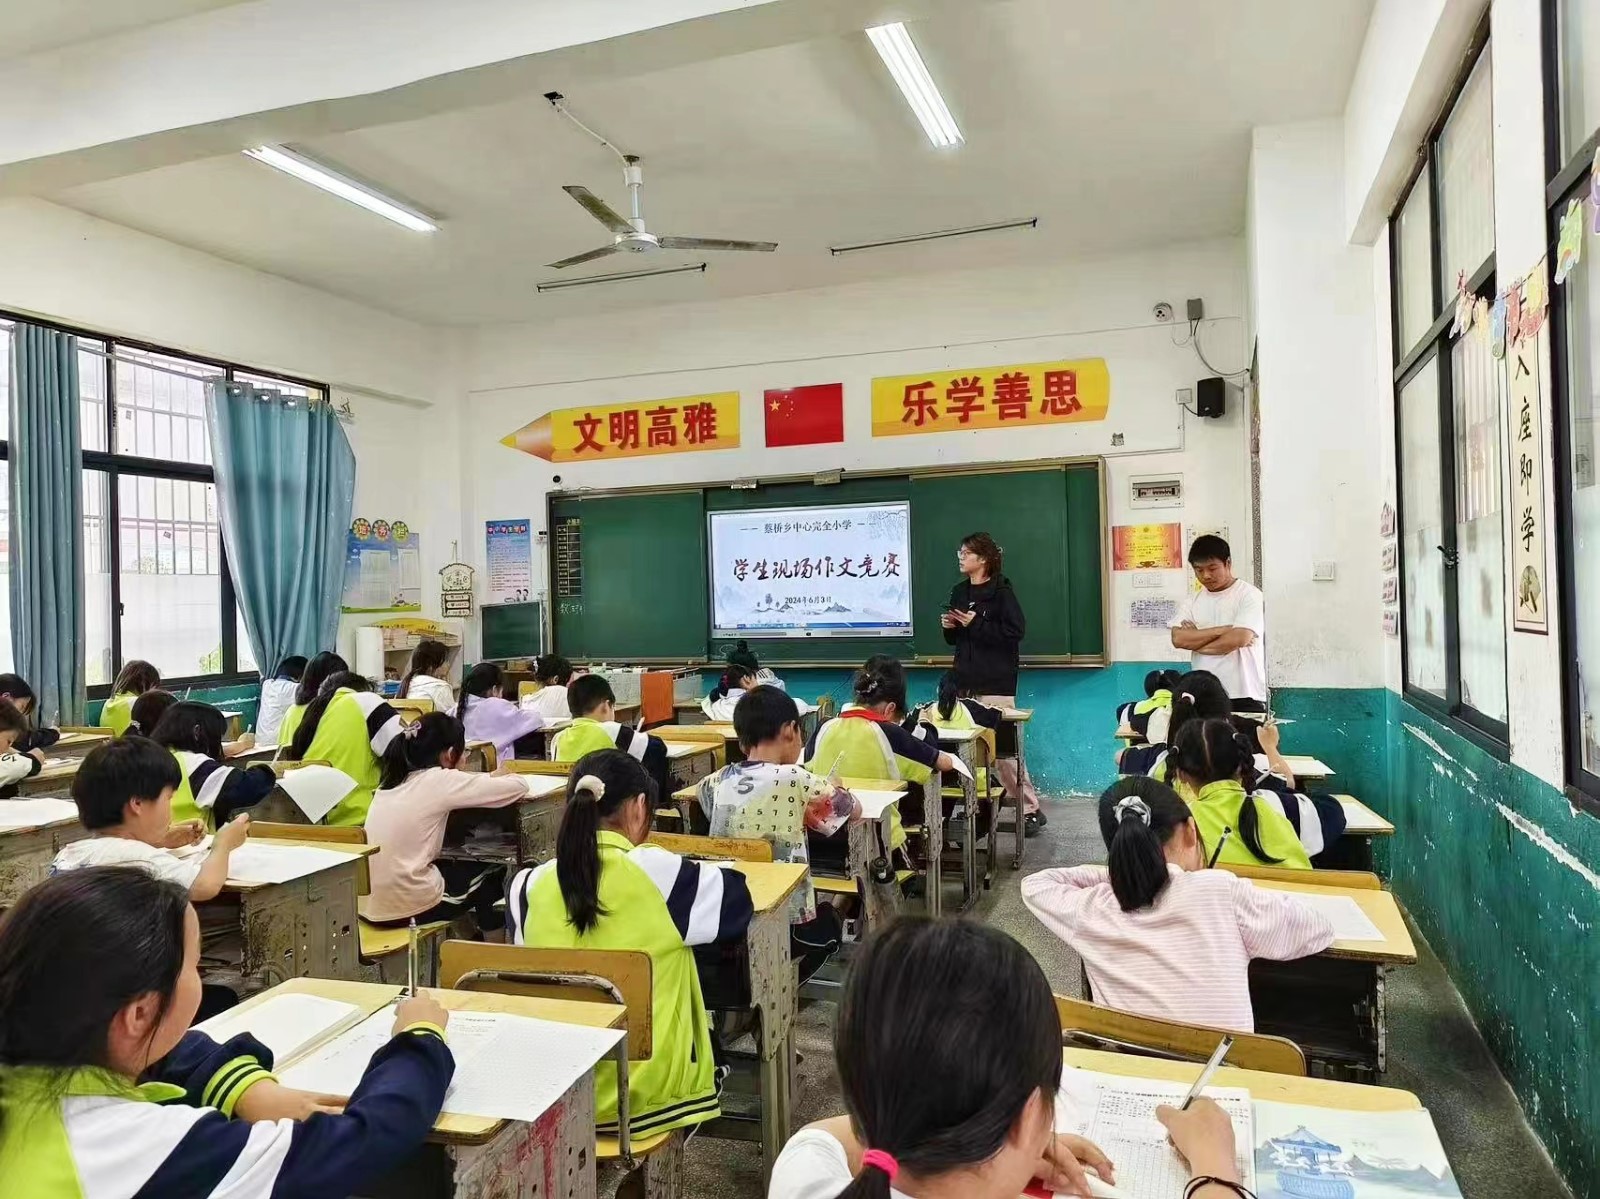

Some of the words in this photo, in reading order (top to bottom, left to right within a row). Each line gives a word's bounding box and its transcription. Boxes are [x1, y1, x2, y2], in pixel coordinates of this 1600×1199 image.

[902, 370, 1082, 426] 乐学善思
[573, 402, 717, 453] 文明高雅
[1515, 354, 1535, 552] 入座即学
[764, 519, 852, 534] 蔡桥乡中心完全小学
[733, 552, 900, 582] 学生现场作文竞赛
[785, 596, 832, 605] 2024年6月3日
